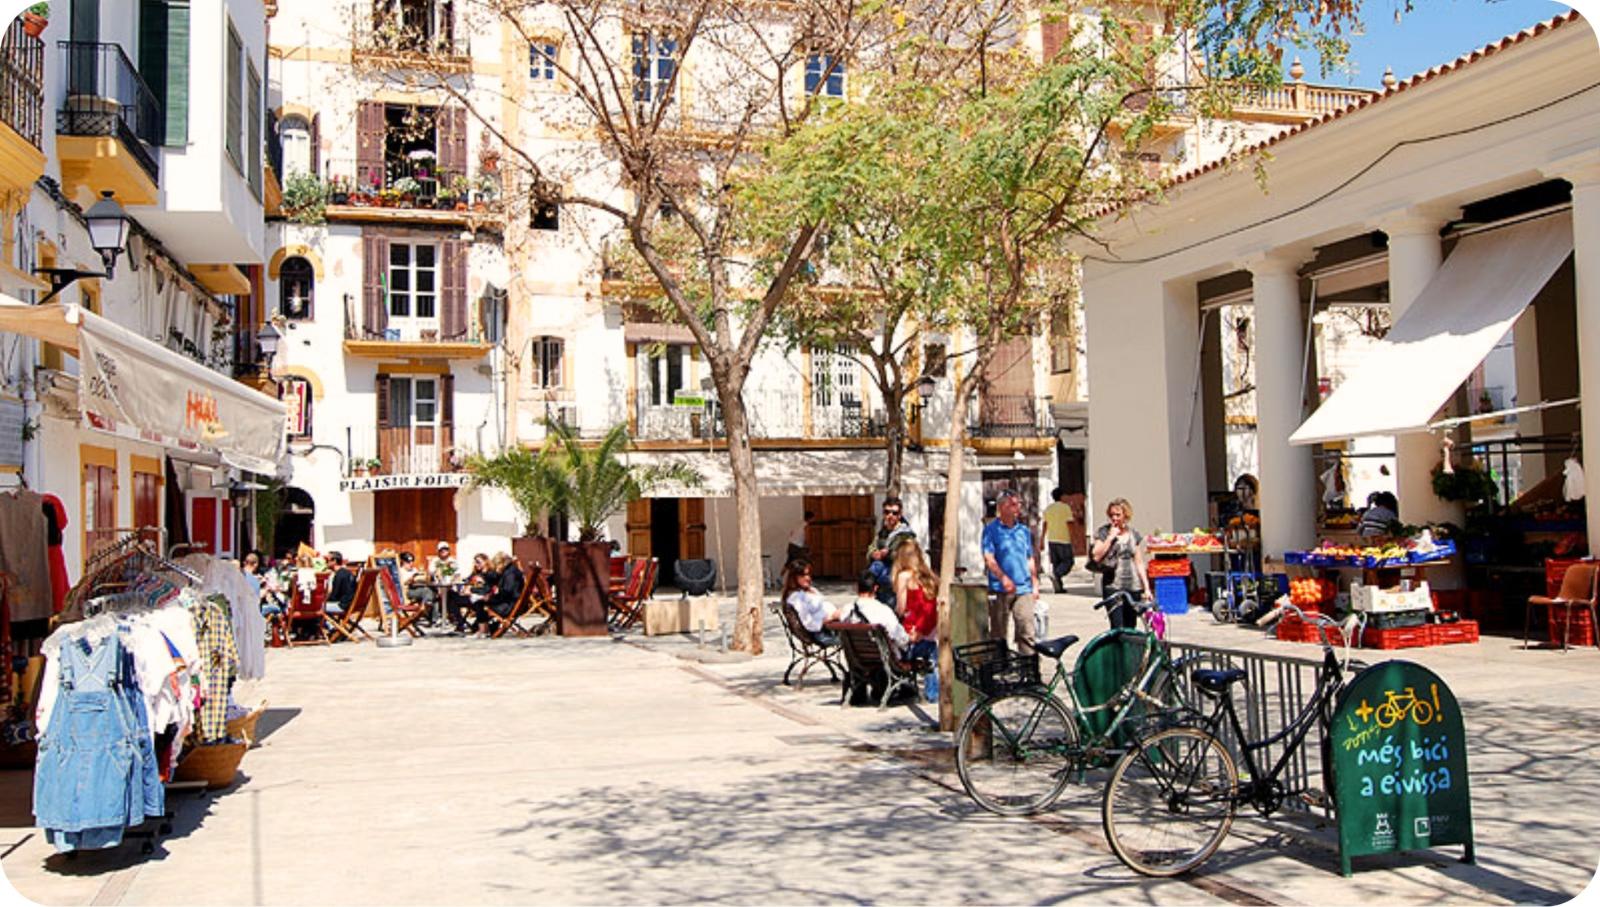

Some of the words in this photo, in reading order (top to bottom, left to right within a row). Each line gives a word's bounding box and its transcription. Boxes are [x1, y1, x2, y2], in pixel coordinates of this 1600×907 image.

[339, 475, 409, 492] PLAISIR
[1357, 735, 1404, 767] més
[1410, 735, 1449, 762] bici
[1360, 776, 1374, 797] a
[1380, 767, 1452, 796] eivissa
